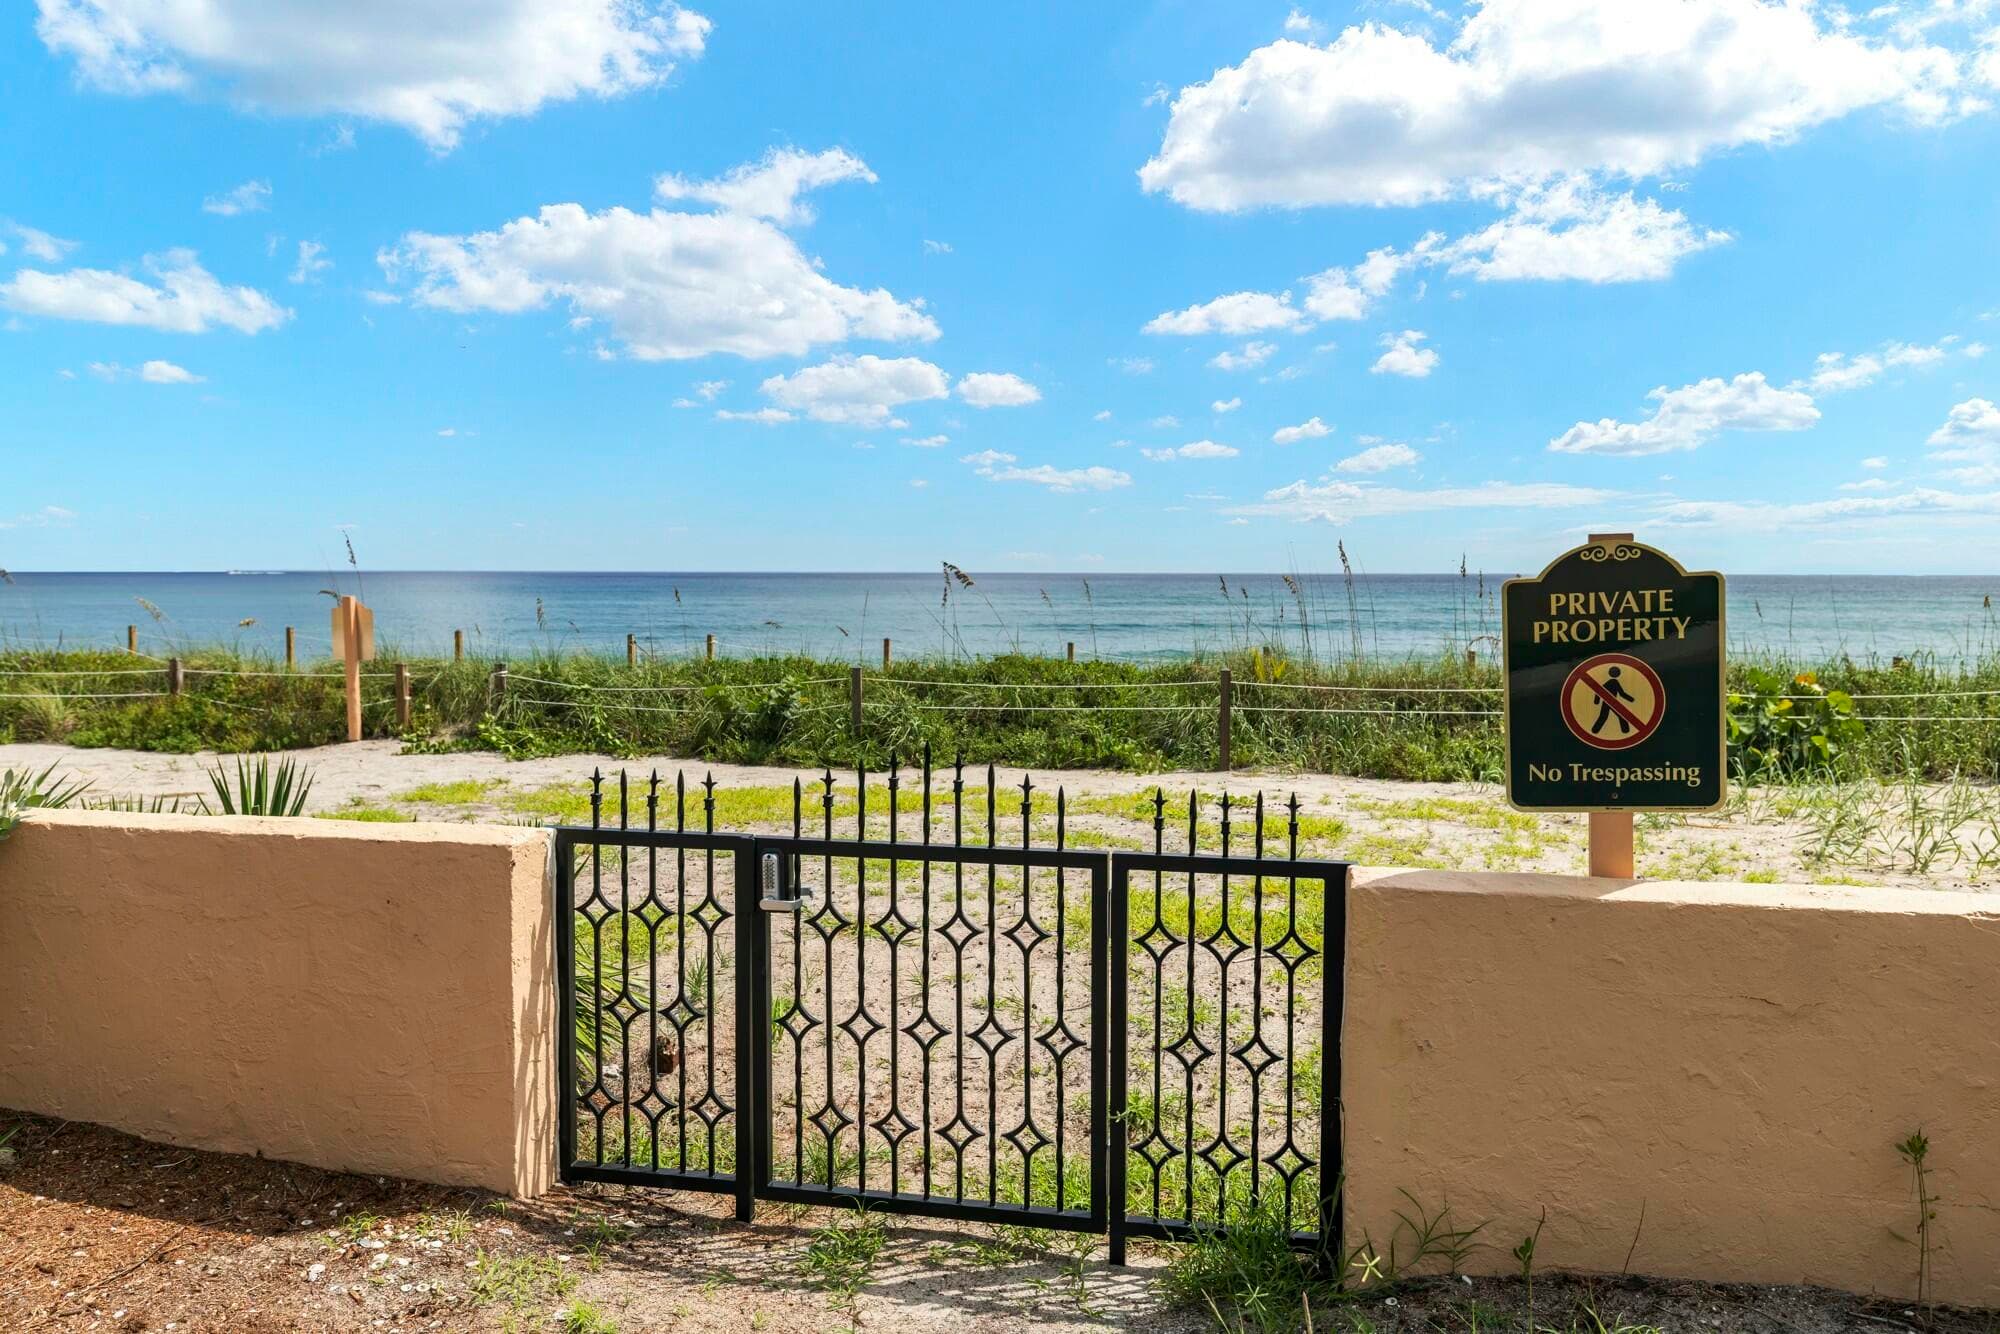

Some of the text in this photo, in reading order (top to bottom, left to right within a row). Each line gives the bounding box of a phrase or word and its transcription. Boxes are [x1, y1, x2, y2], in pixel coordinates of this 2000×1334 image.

[1550, 589, 1673, 615] PRIVATE
[1533, 616, 1691, 643] PROPERTY
[1529, 761, 1701, 787] No Trespassing
